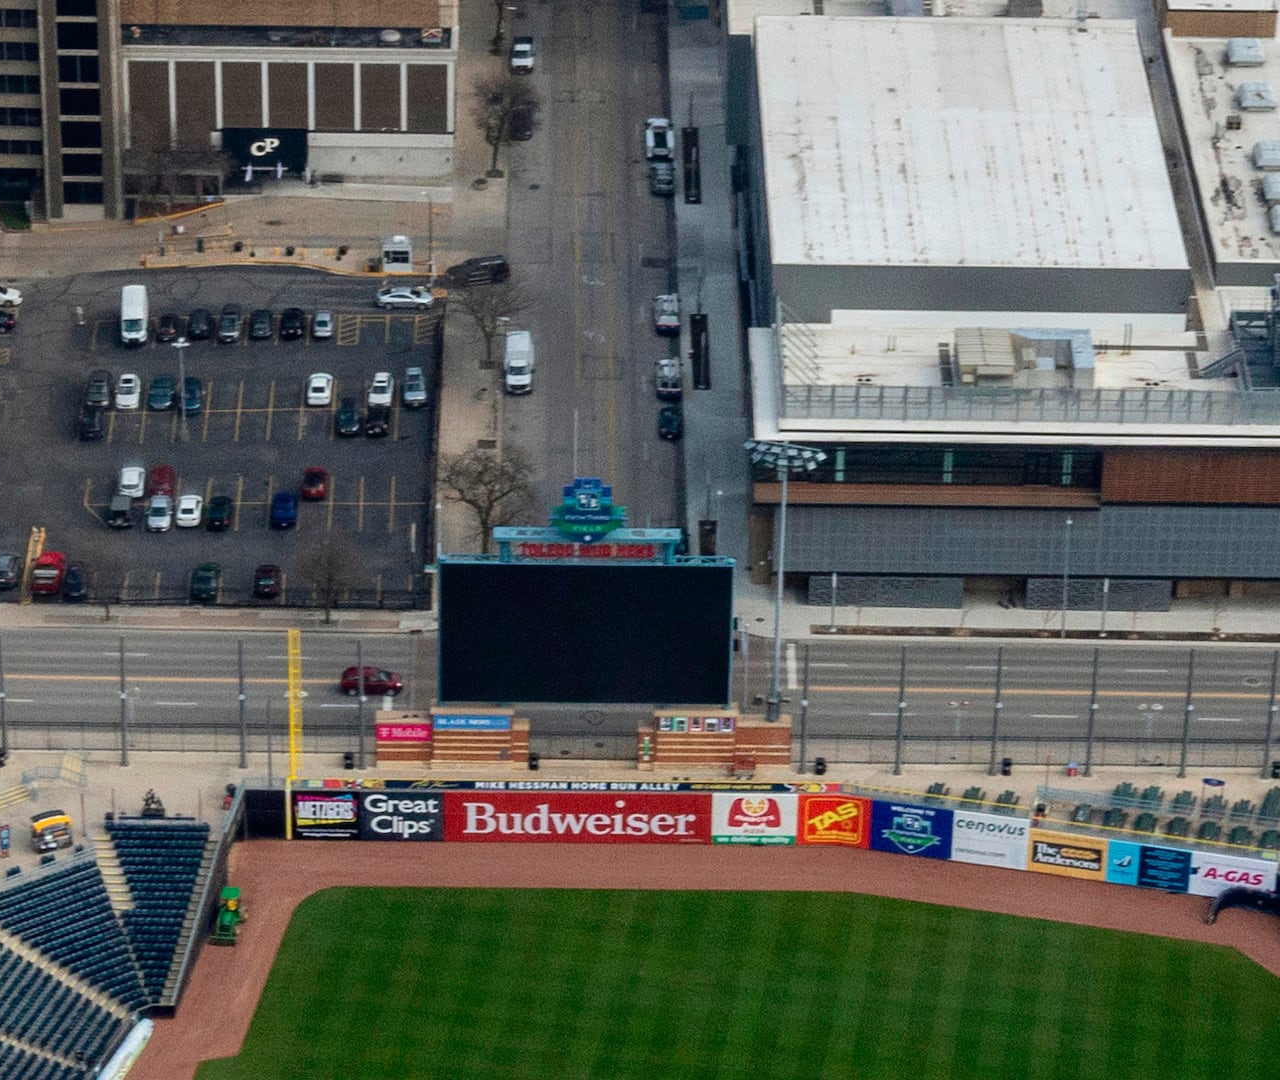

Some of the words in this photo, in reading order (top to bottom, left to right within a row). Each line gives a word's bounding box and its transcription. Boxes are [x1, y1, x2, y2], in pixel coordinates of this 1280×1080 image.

[250, 138, 280, 156] CP
[520, 543, 574, 559] TOLEDO
[475, 781, 506, 790] MIKE
[508, 781, 569, 790] HESSMAN
[571, 781, 608, 790] HOME
[610, 782, 638, 790] RUN
[640, 782, 679, 791] ALLEY
[364, 794, 439, 814] Great
[462, 800, 696, 836] Budweiser
[808, 802, 859, 831] TAS
[370, 815, 431, 838] Clips
[956, 818, 1026, 837] cenovus
[1034, 842, 1059, 855] The
[1033, 853, 1101, 871] Andersons
[1203, 867, 1265, 886] A-GAS
